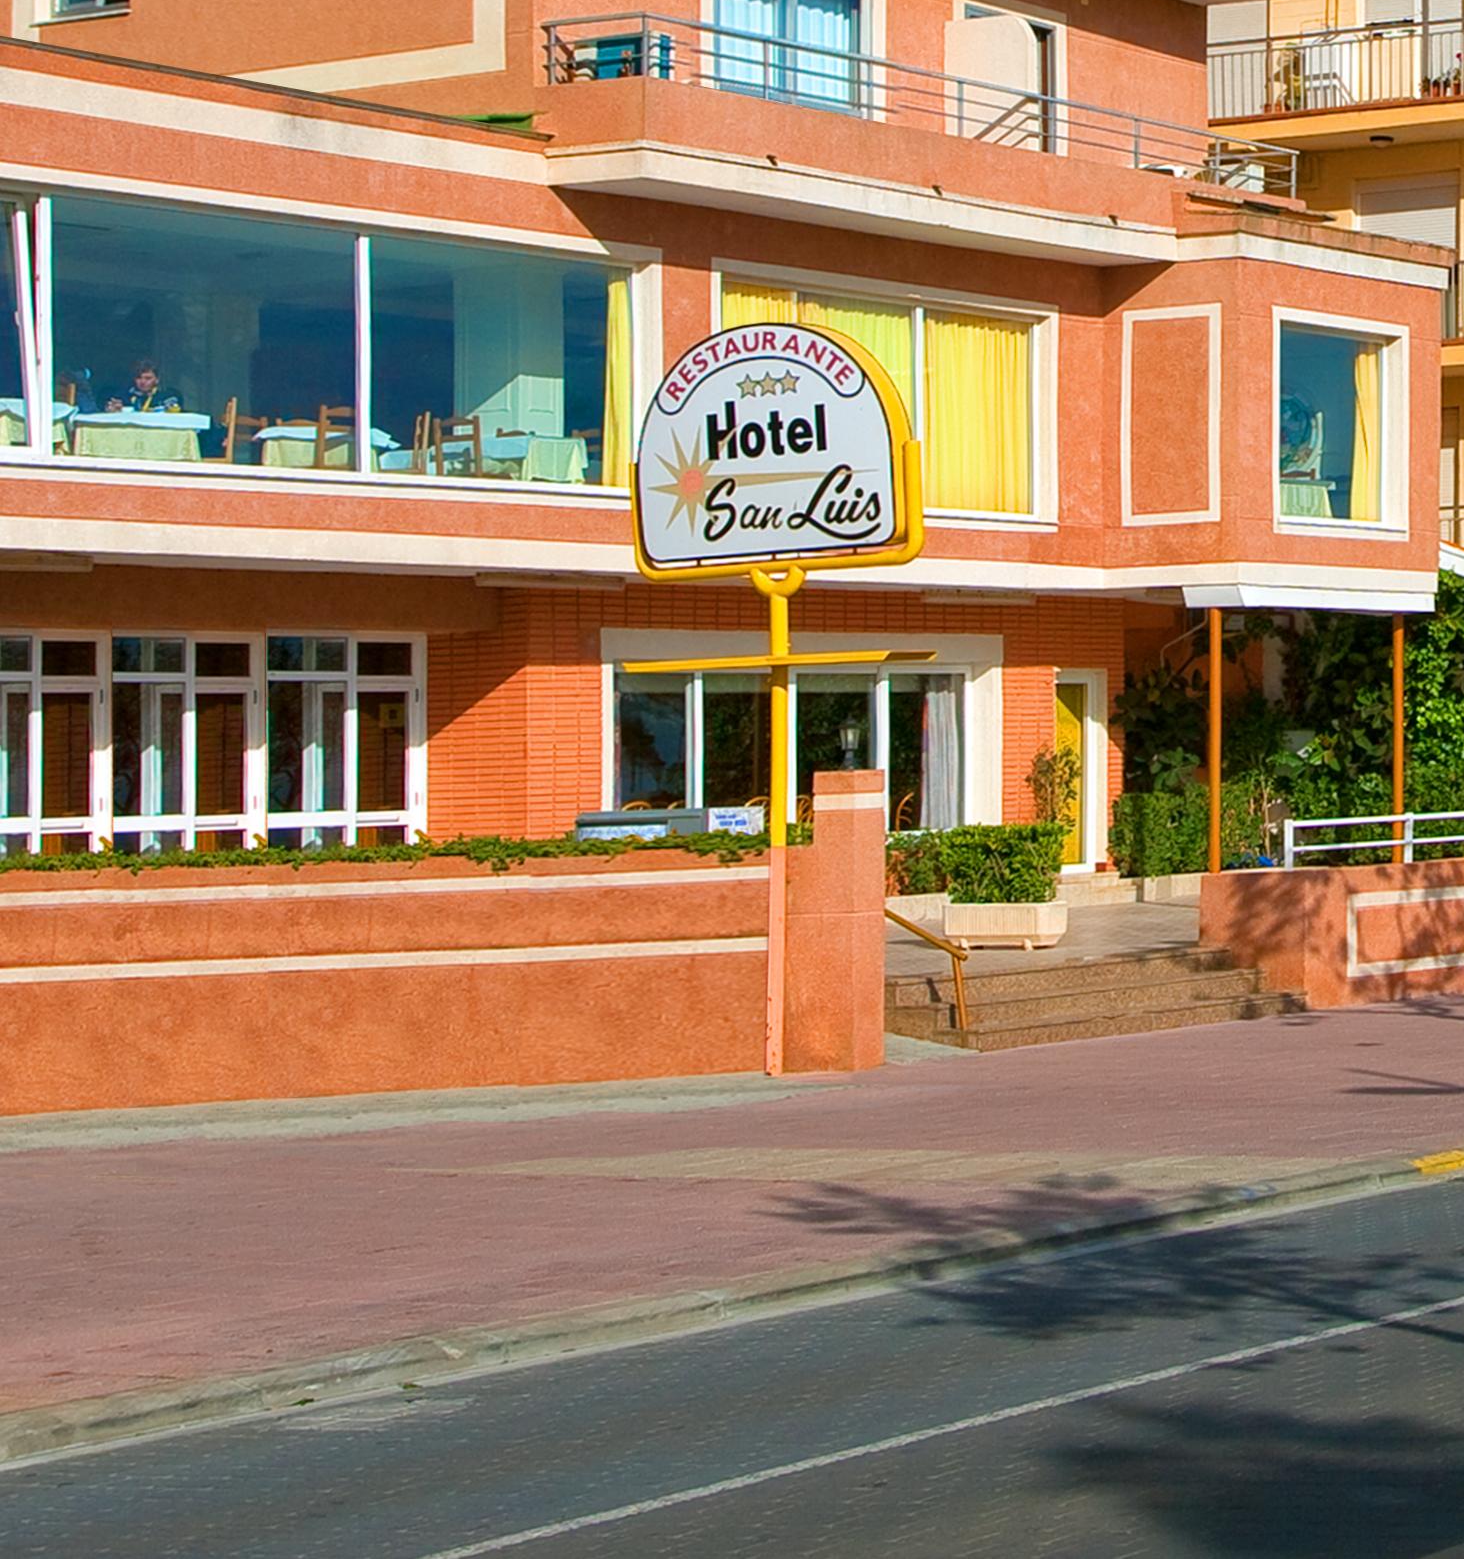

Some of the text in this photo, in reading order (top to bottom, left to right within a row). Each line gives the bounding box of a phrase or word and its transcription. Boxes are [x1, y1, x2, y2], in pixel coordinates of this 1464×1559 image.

[664, 331, 856, 402] RESTAURANTE
[706, 400, 827, 461] Hotel
[703, 463, 881, 542] San Luis
